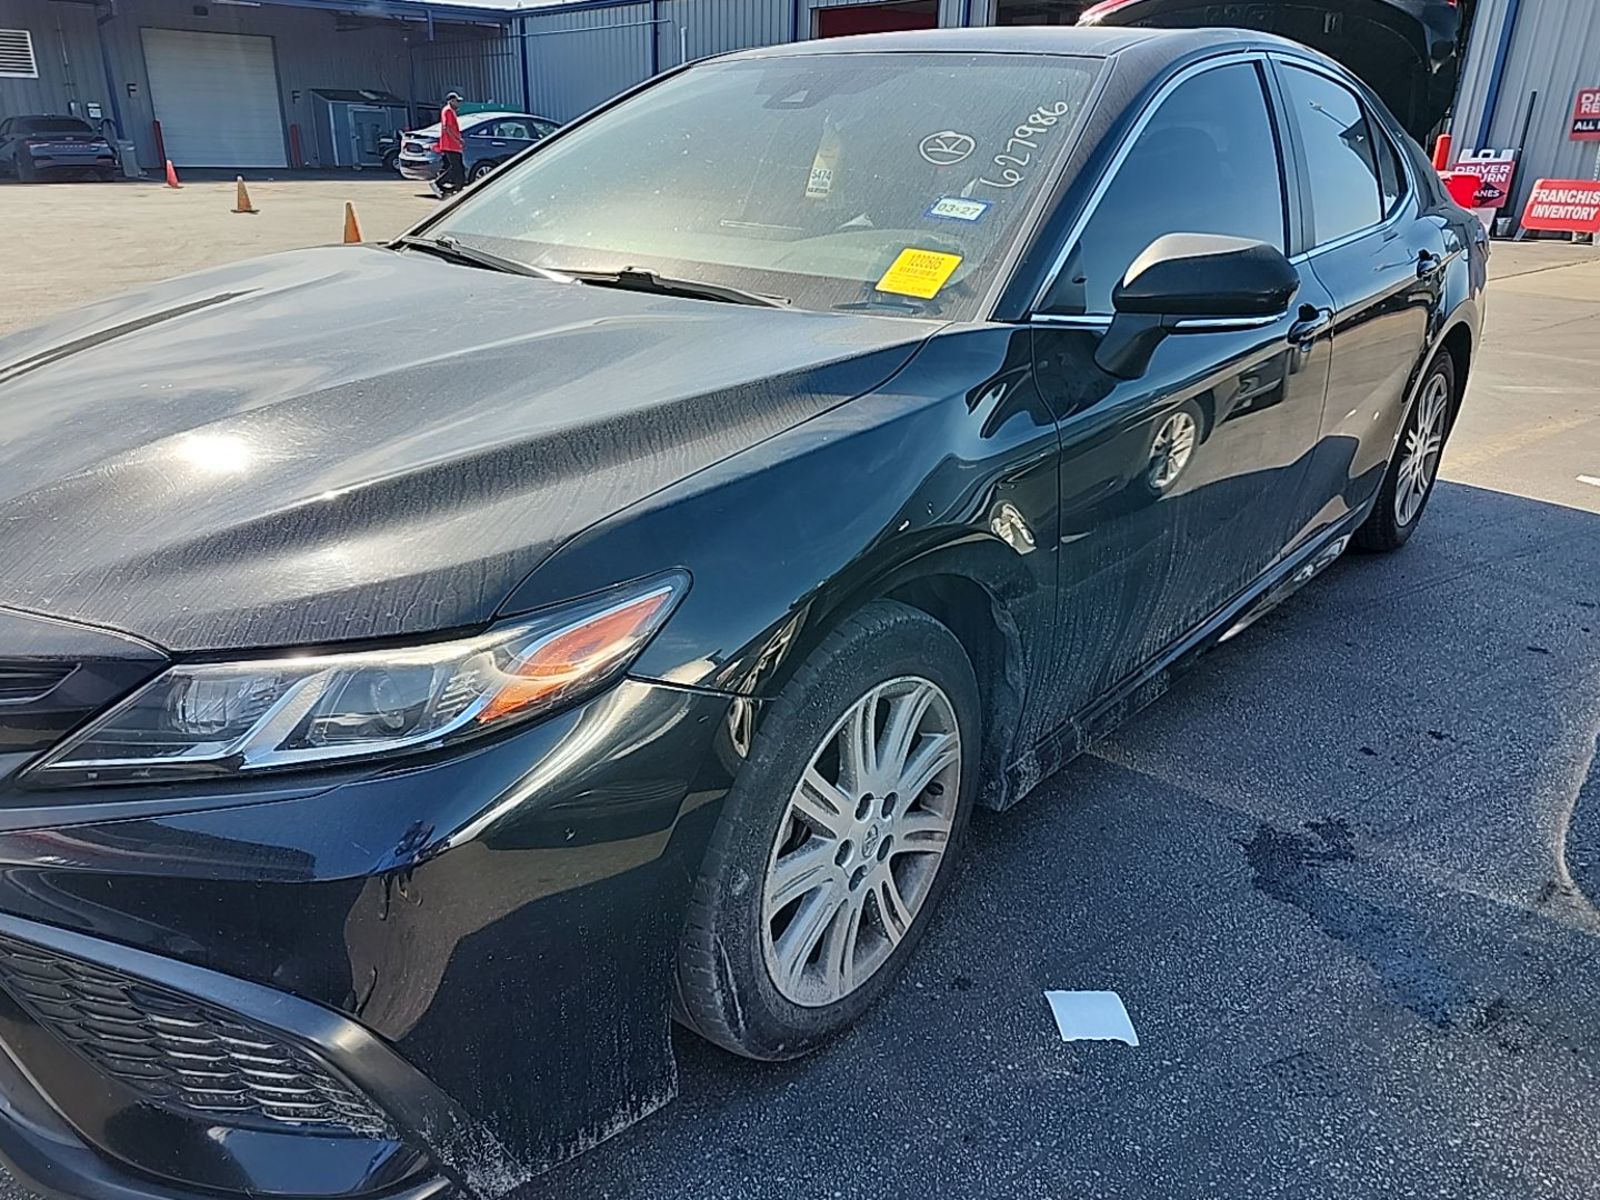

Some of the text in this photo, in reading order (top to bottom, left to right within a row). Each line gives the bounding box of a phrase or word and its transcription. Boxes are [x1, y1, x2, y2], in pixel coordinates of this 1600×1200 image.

[126, 83, 137, 98] F
[291, 90, 301, 104] F
[1574, 121, 1595, 131] ALL
[979, 101, 1068, 188] 627986
[1455, 164, 1511, 174] DRIVER
[1474, 189, 1500, 198] ANES
[1531, 204, 1599, 220] INVENTORY
